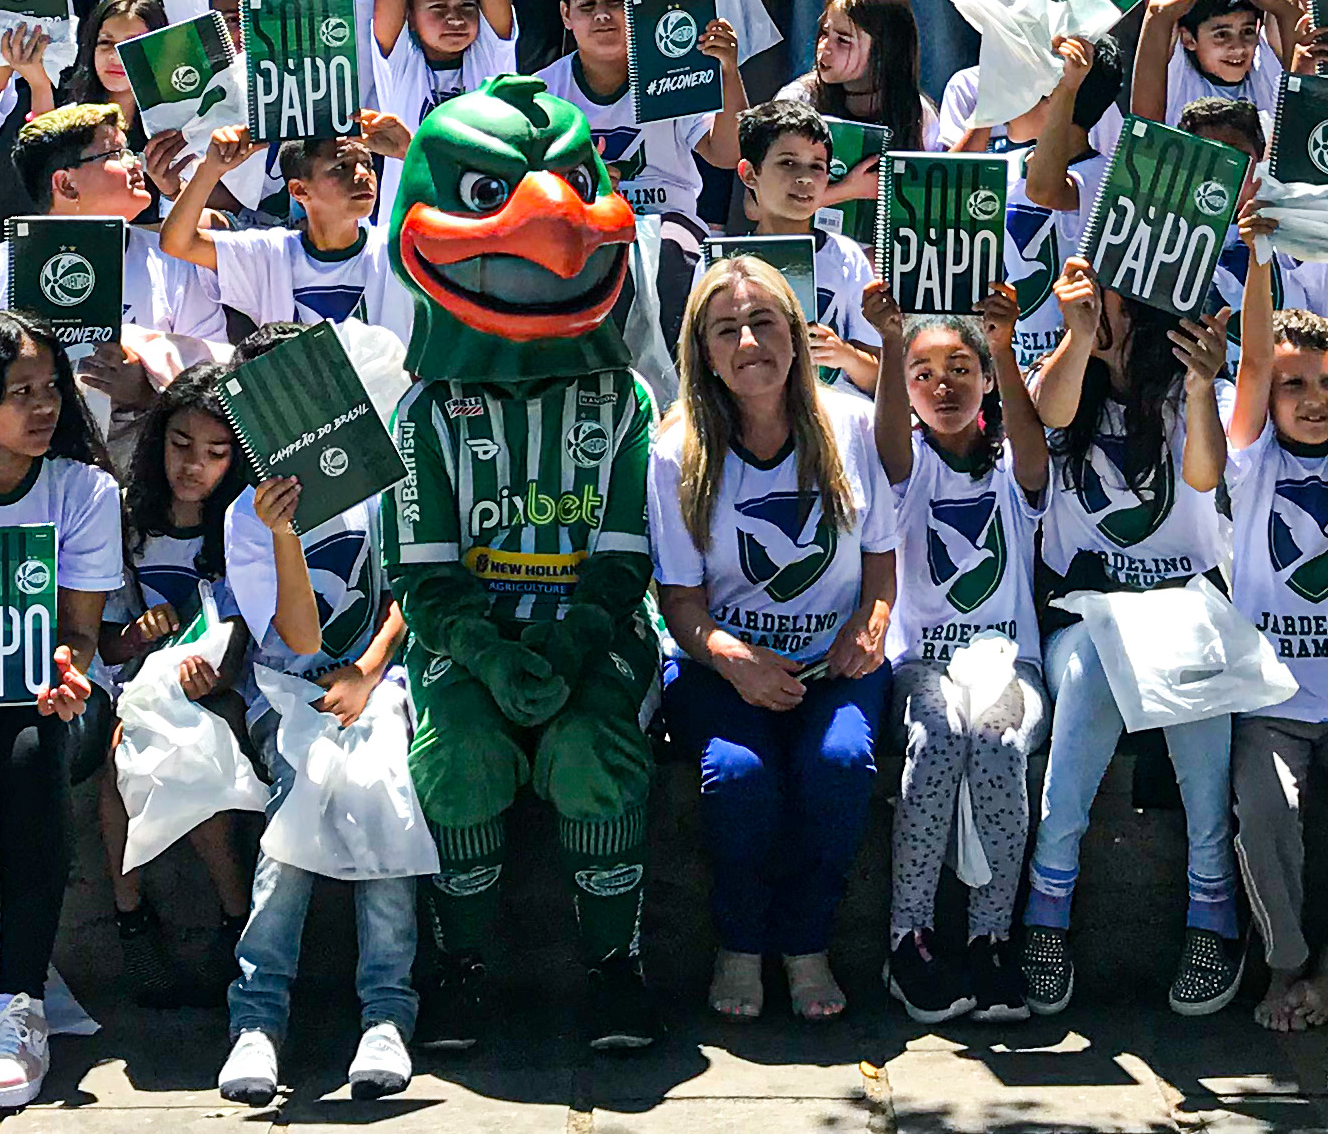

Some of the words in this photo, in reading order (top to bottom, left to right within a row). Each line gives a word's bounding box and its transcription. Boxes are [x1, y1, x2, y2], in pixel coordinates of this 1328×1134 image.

[257, 55, 354, 139] PAPO
[646, 69, 715, 96] #JACONERO
[893, 228, 998, 311] PAPO
[1093, 196, 1214, 311] PAPO
[269, 430, 315, 465] CAMPEÃO
[317, 423, 332, 440] DO
[333, 403, 369, 431] BRASIL
[472, 482, 601, 536] pixbet
[489, 582, 566, 594] AGRICULTURE
[491, 561, 522, 575] NEW
[714, 609, 839, 634] JARDELINO
